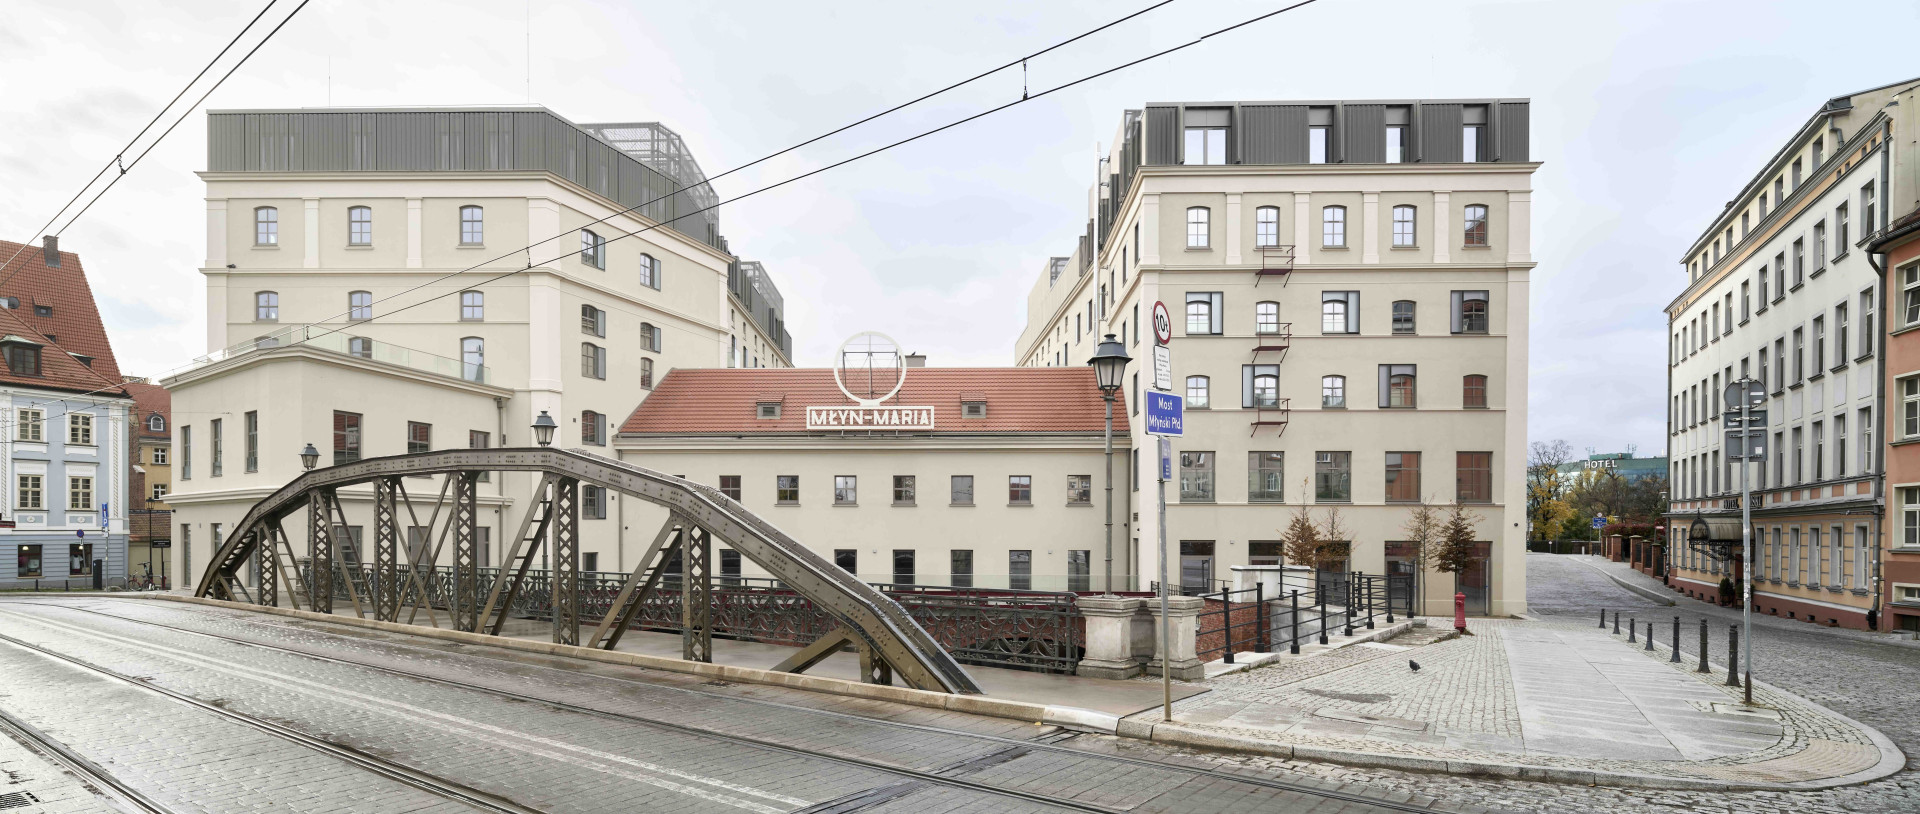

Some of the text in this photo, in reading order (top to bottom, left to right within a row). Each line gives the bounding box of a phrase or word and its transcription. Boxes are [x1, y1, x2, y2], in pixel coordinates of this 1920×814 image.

[1155, 313, 1169, 333] 10t
[1158, 397, 1173, 411] Most
[811, 410, 929, 425] MŁYN-MARIA
[1148, 414, 1171, 431] Młyński
[1584, 460, 1618, 469] HOTEL
